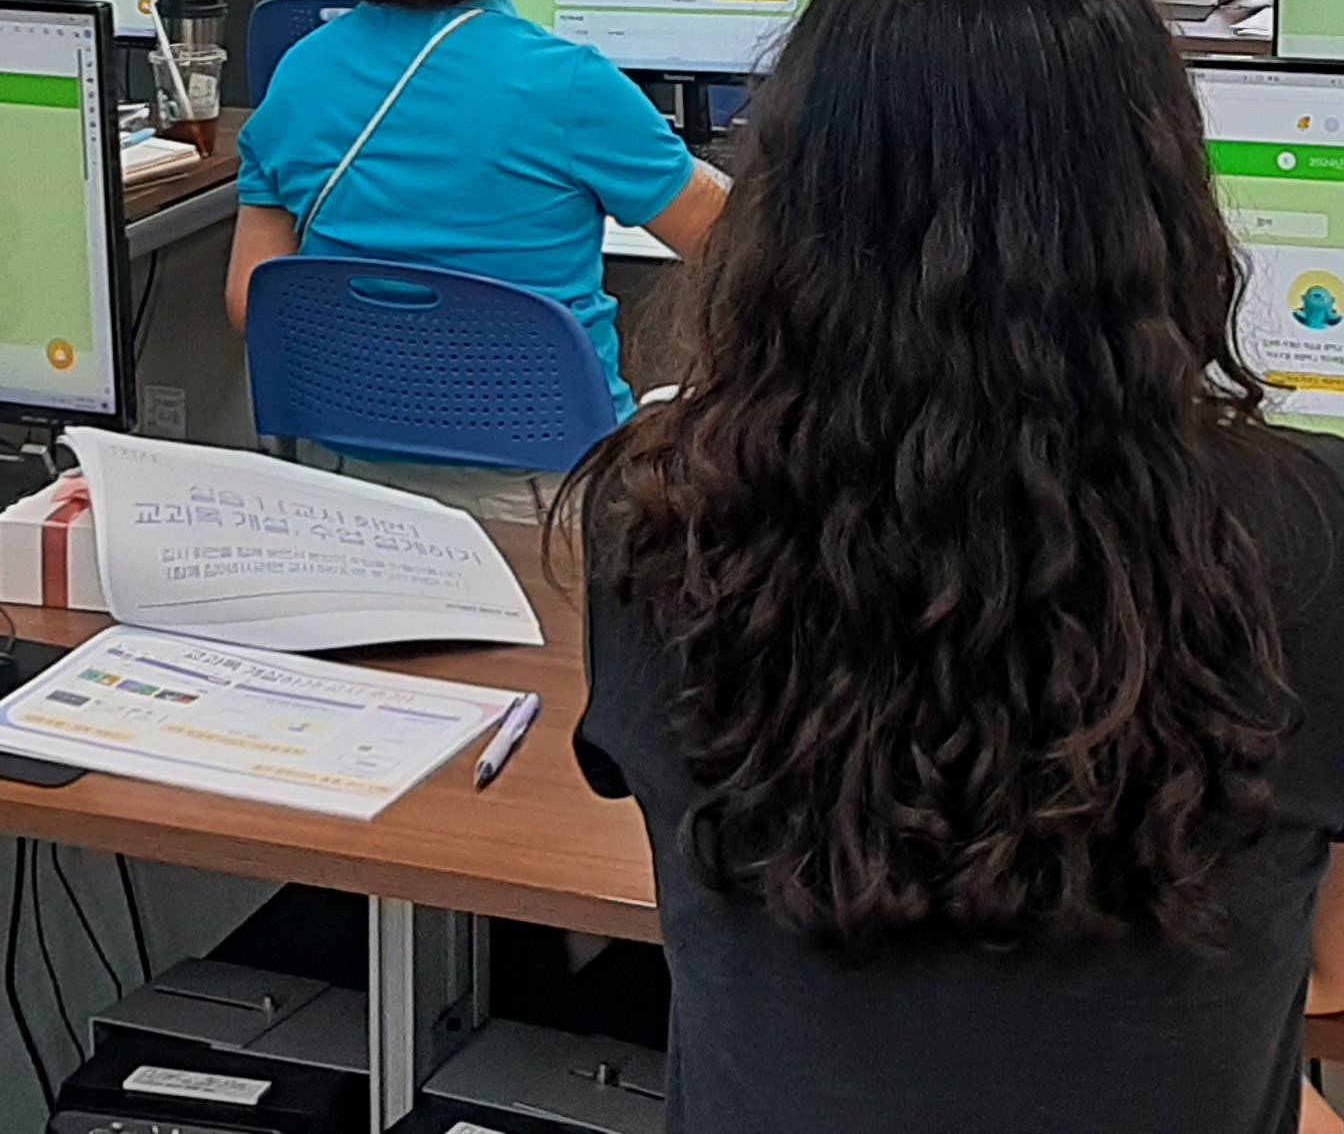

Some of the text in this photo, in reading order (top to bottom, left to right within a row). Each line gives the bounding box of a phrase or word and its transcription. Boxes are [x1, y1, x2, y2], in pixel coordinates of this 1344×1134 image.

[189, 485, 245, 508] 실습
[133, 502, 223, 528] 교과목
[310, 523, 365, 546] 수업
[373, 534, 483, 566] 설계하기
[183, 648, 242, 672] 교과목
